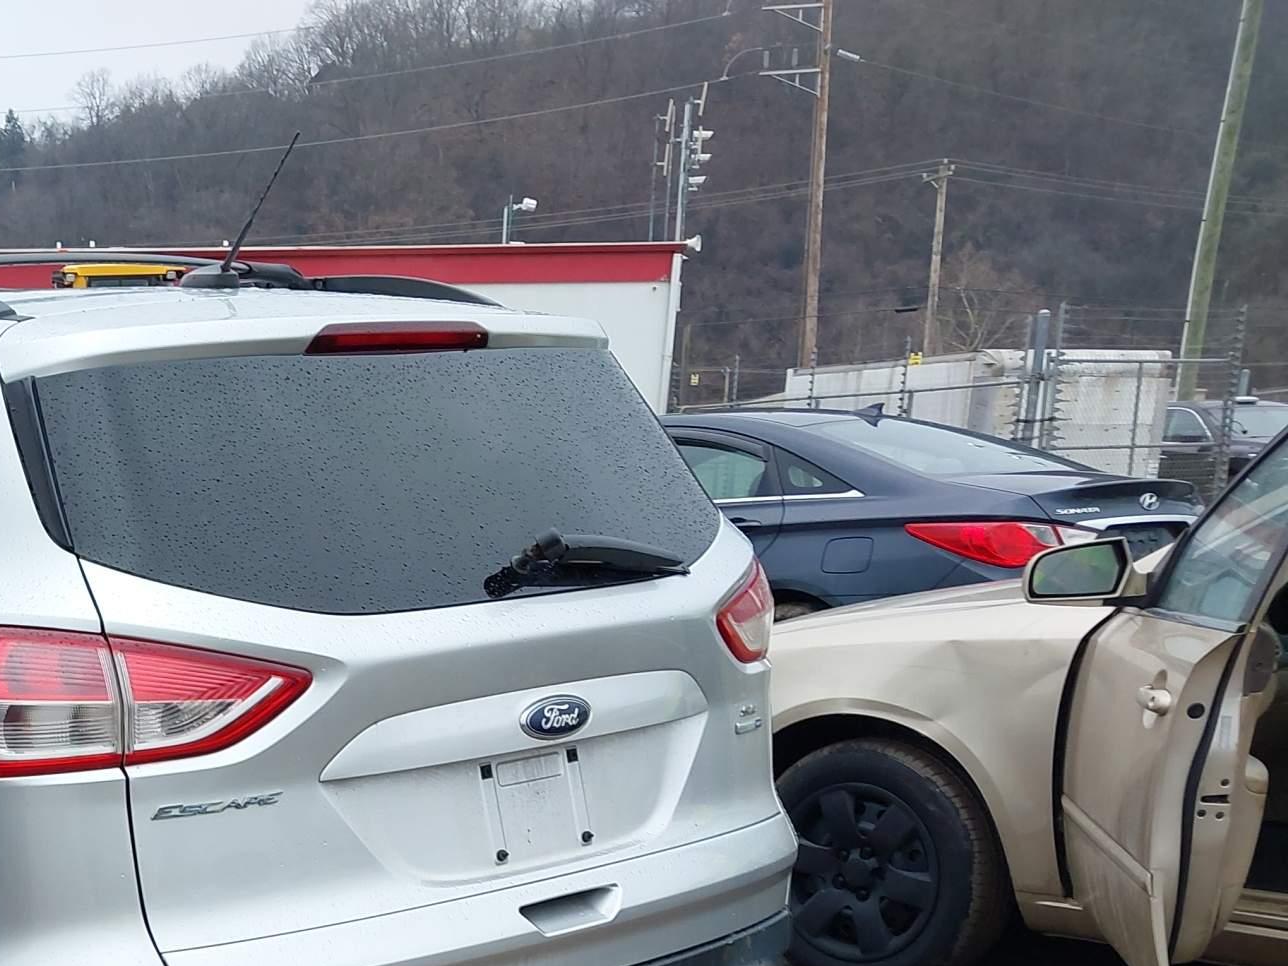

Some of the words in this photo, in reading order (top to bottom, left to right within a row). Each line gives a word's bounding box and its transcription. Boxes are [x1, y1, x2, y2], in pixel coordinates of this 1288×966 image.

[1055, 507, 1100, 515] SONATA
[541, 703, 580, 730] Ford
[150, 791, 285, 821] ESCAPE
